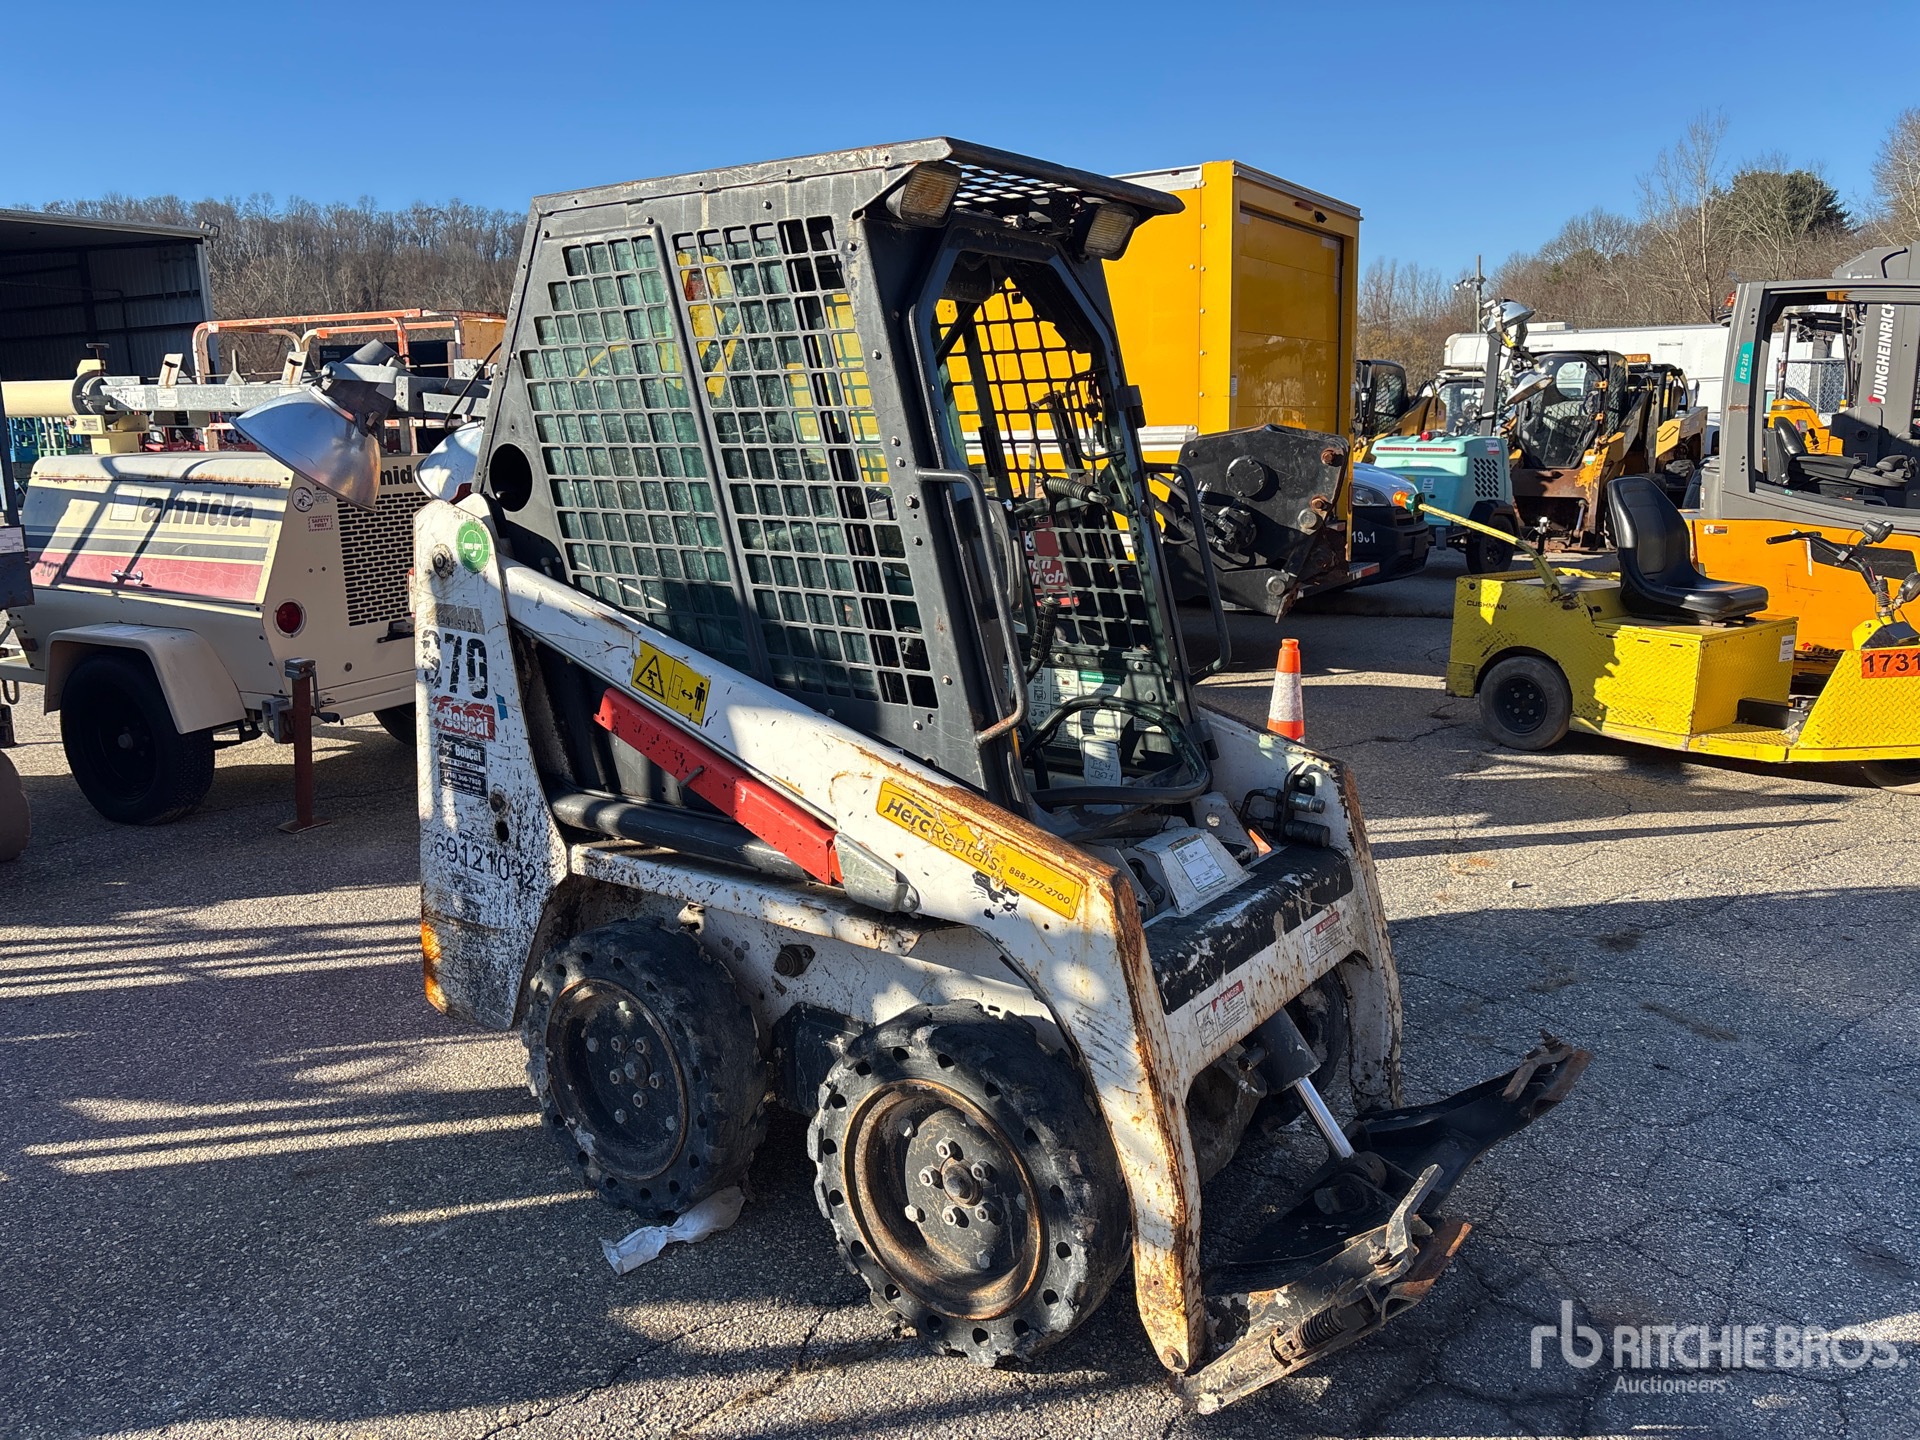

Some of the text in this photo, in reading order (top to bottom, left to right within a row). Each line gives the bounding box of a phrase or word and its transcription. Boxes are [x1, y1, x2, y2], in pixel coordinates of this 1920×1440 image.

[1739, 353, 1749, 380] EFG 216
[140, 489, 254, 527] amida
[1466, 600, 1508, 611] CUSHMAN
[443, 706, 489, 737] Bobcat
[885, 797, 1071, 906] HercRentals 888-777-2700
[1221, 985, 1240, 1004] DANGER
